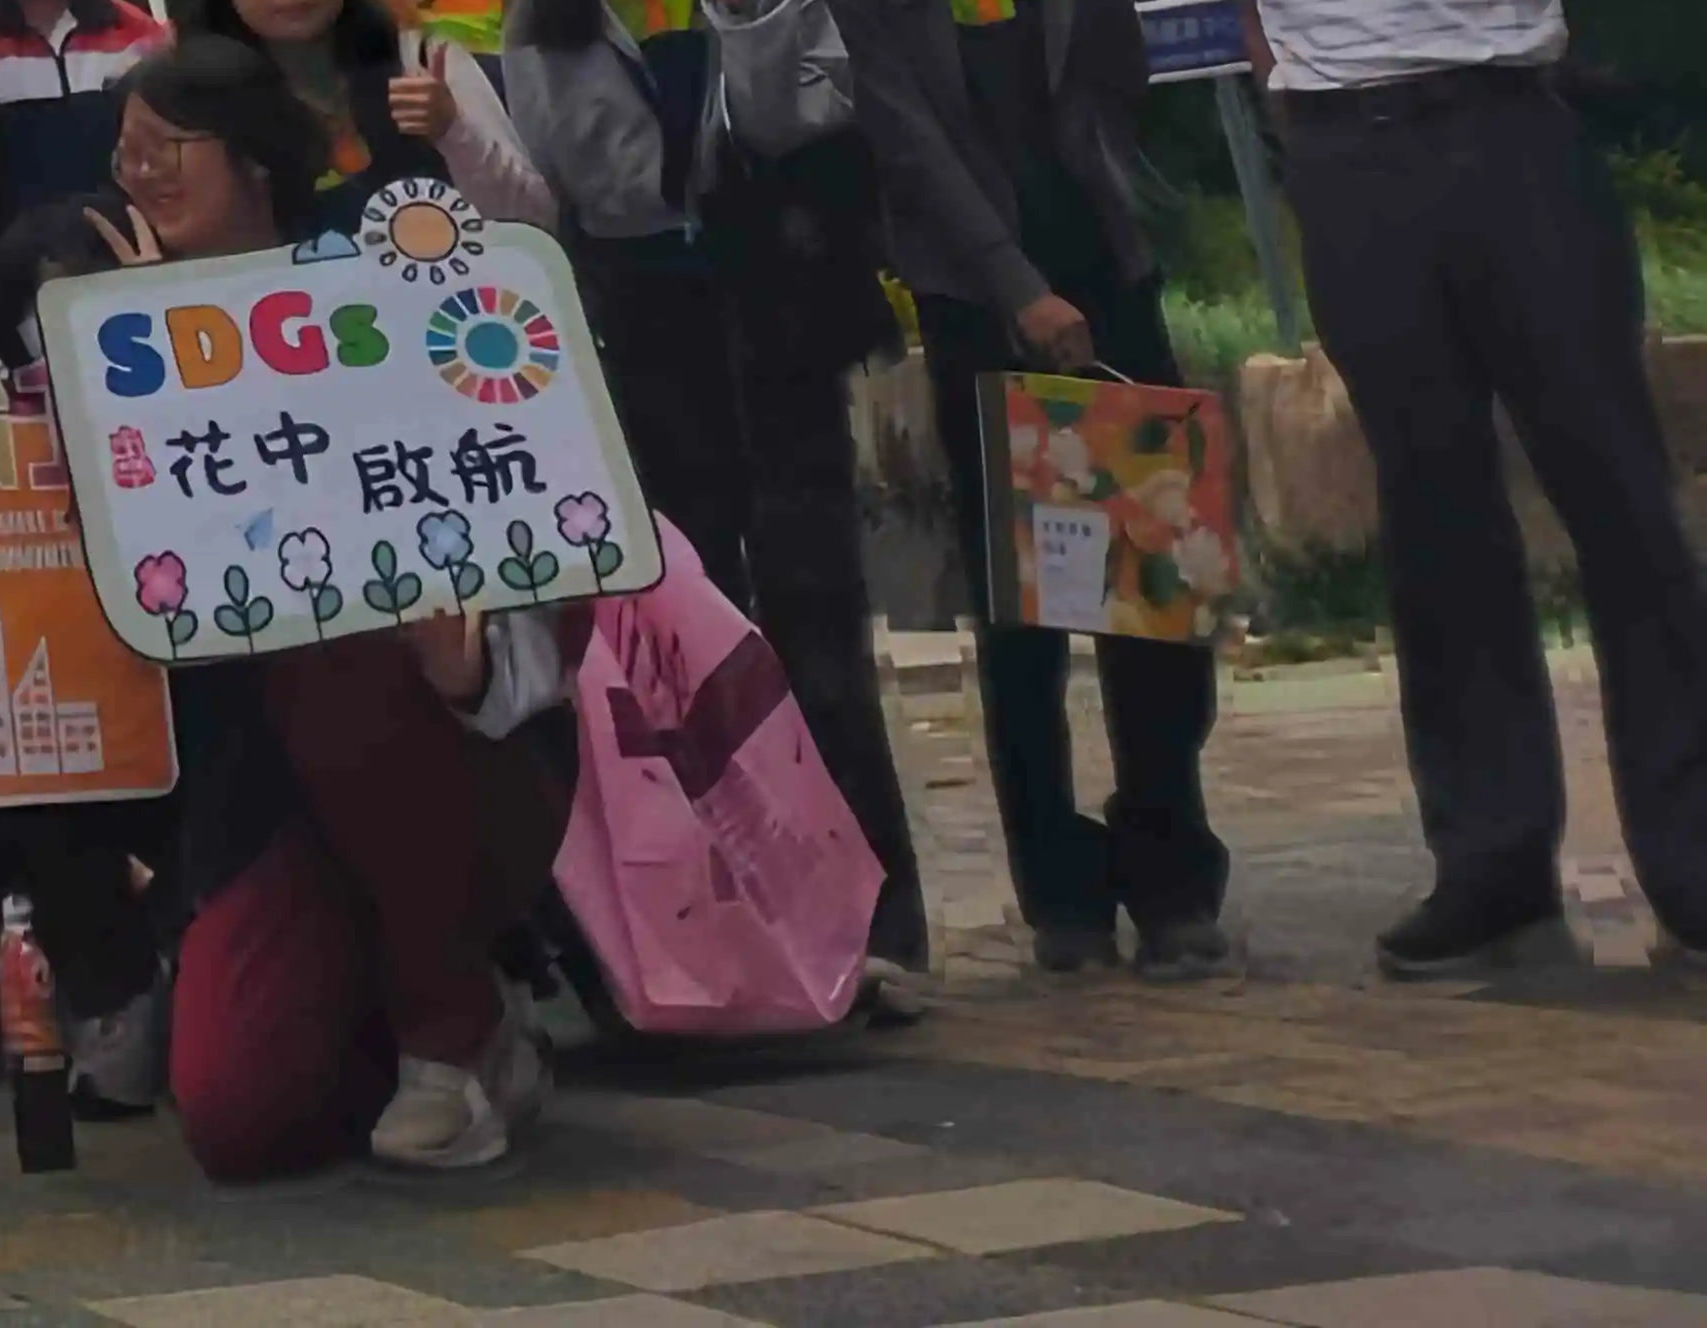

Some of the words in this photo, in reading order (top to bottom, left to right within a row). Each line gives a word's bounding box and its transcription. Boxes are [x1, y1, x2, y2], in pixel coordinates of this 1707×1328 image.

[96, 289, 391, 398] SDGs
[164, 410, 547, 514] 花中啟航
